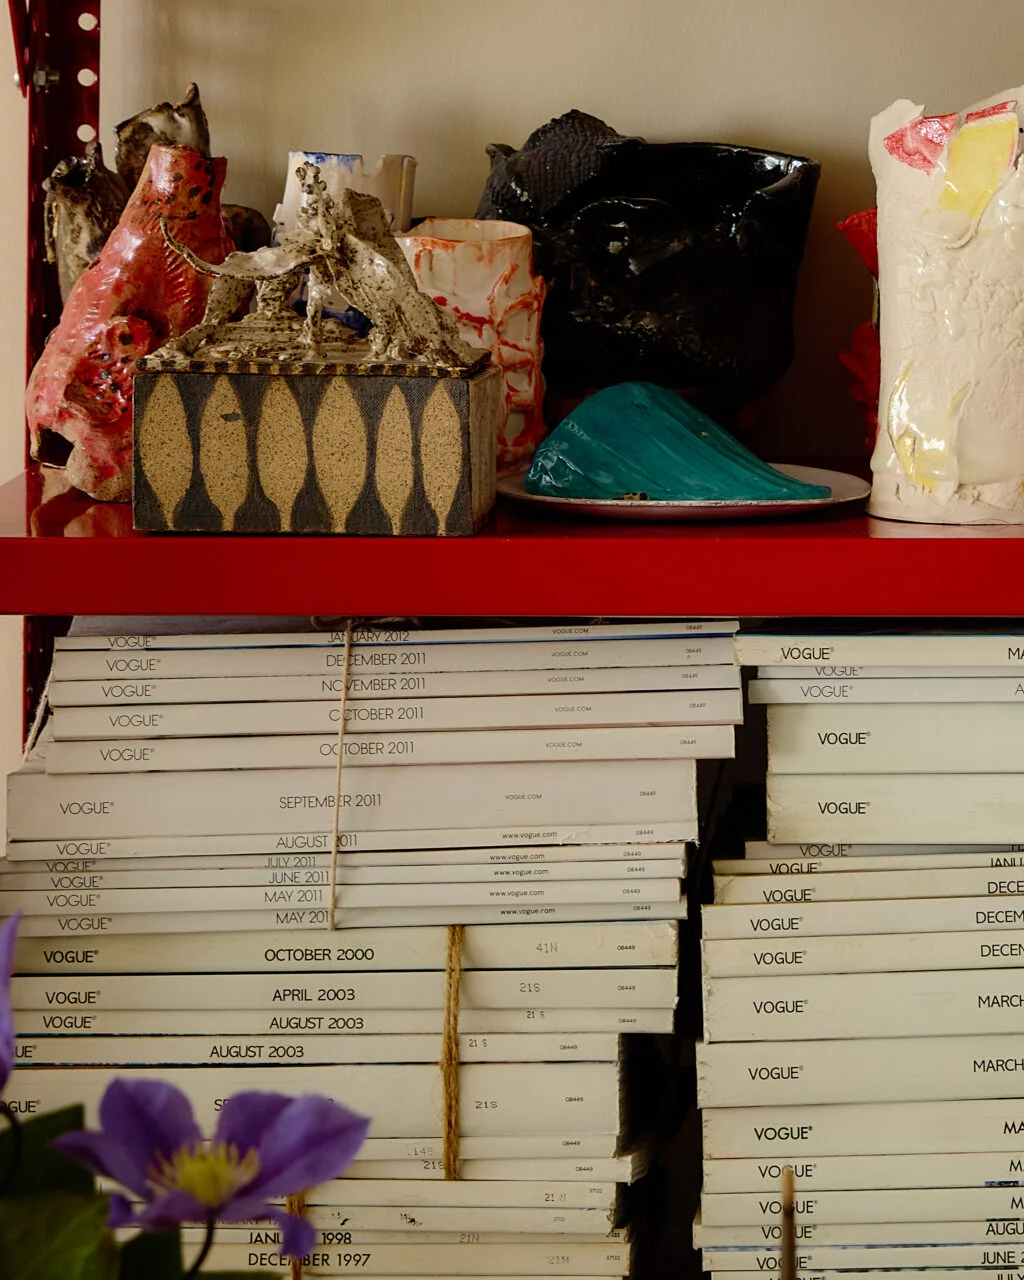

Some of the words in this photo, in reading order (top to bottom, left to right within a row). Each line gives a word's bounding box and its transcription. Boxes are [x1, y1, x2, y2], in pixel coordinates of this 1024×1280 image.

[400, 653, 426, 665] 2011
[400, 678, 425, 690] 2011
[398, 707, 423, 719] 2011
[388, 742, 414, 754] 2011
[279, 795, 351, 809] SEPTEMBER
[355, 794, 381, 807] 2011
[276, 836, 328, 848] AUGUST
[265, 857, 290, 868] JULY
[294, 857, 315, 868] 2011
[269, 872, 300, 884] JUNE
[305, 871, 329, 883] 2011
[265, 891, 293, 903] MAY
[297, 890, 322, 902] 2011
[265, 949, 331, 961] OCTOBER
[337, 948, 374, 961] 2000
[272, 989, 312, 1001] APRIL
[318, 989, 355, 1001] 2003
[270, 1017, 324, 1029] AUGUST
[328, 1018, 363, 1029] 2003
[210, 1046, 264, 1058] AUGUST
[268, 1046, 304, 1058] 2003
[973, 1059, 1024, 1072] MARCH
[322, 1232, 352, 1244] 1998
[337, 1254, 371, 1266] 1997
[982, 1251, 1015, 1264] JUNE
